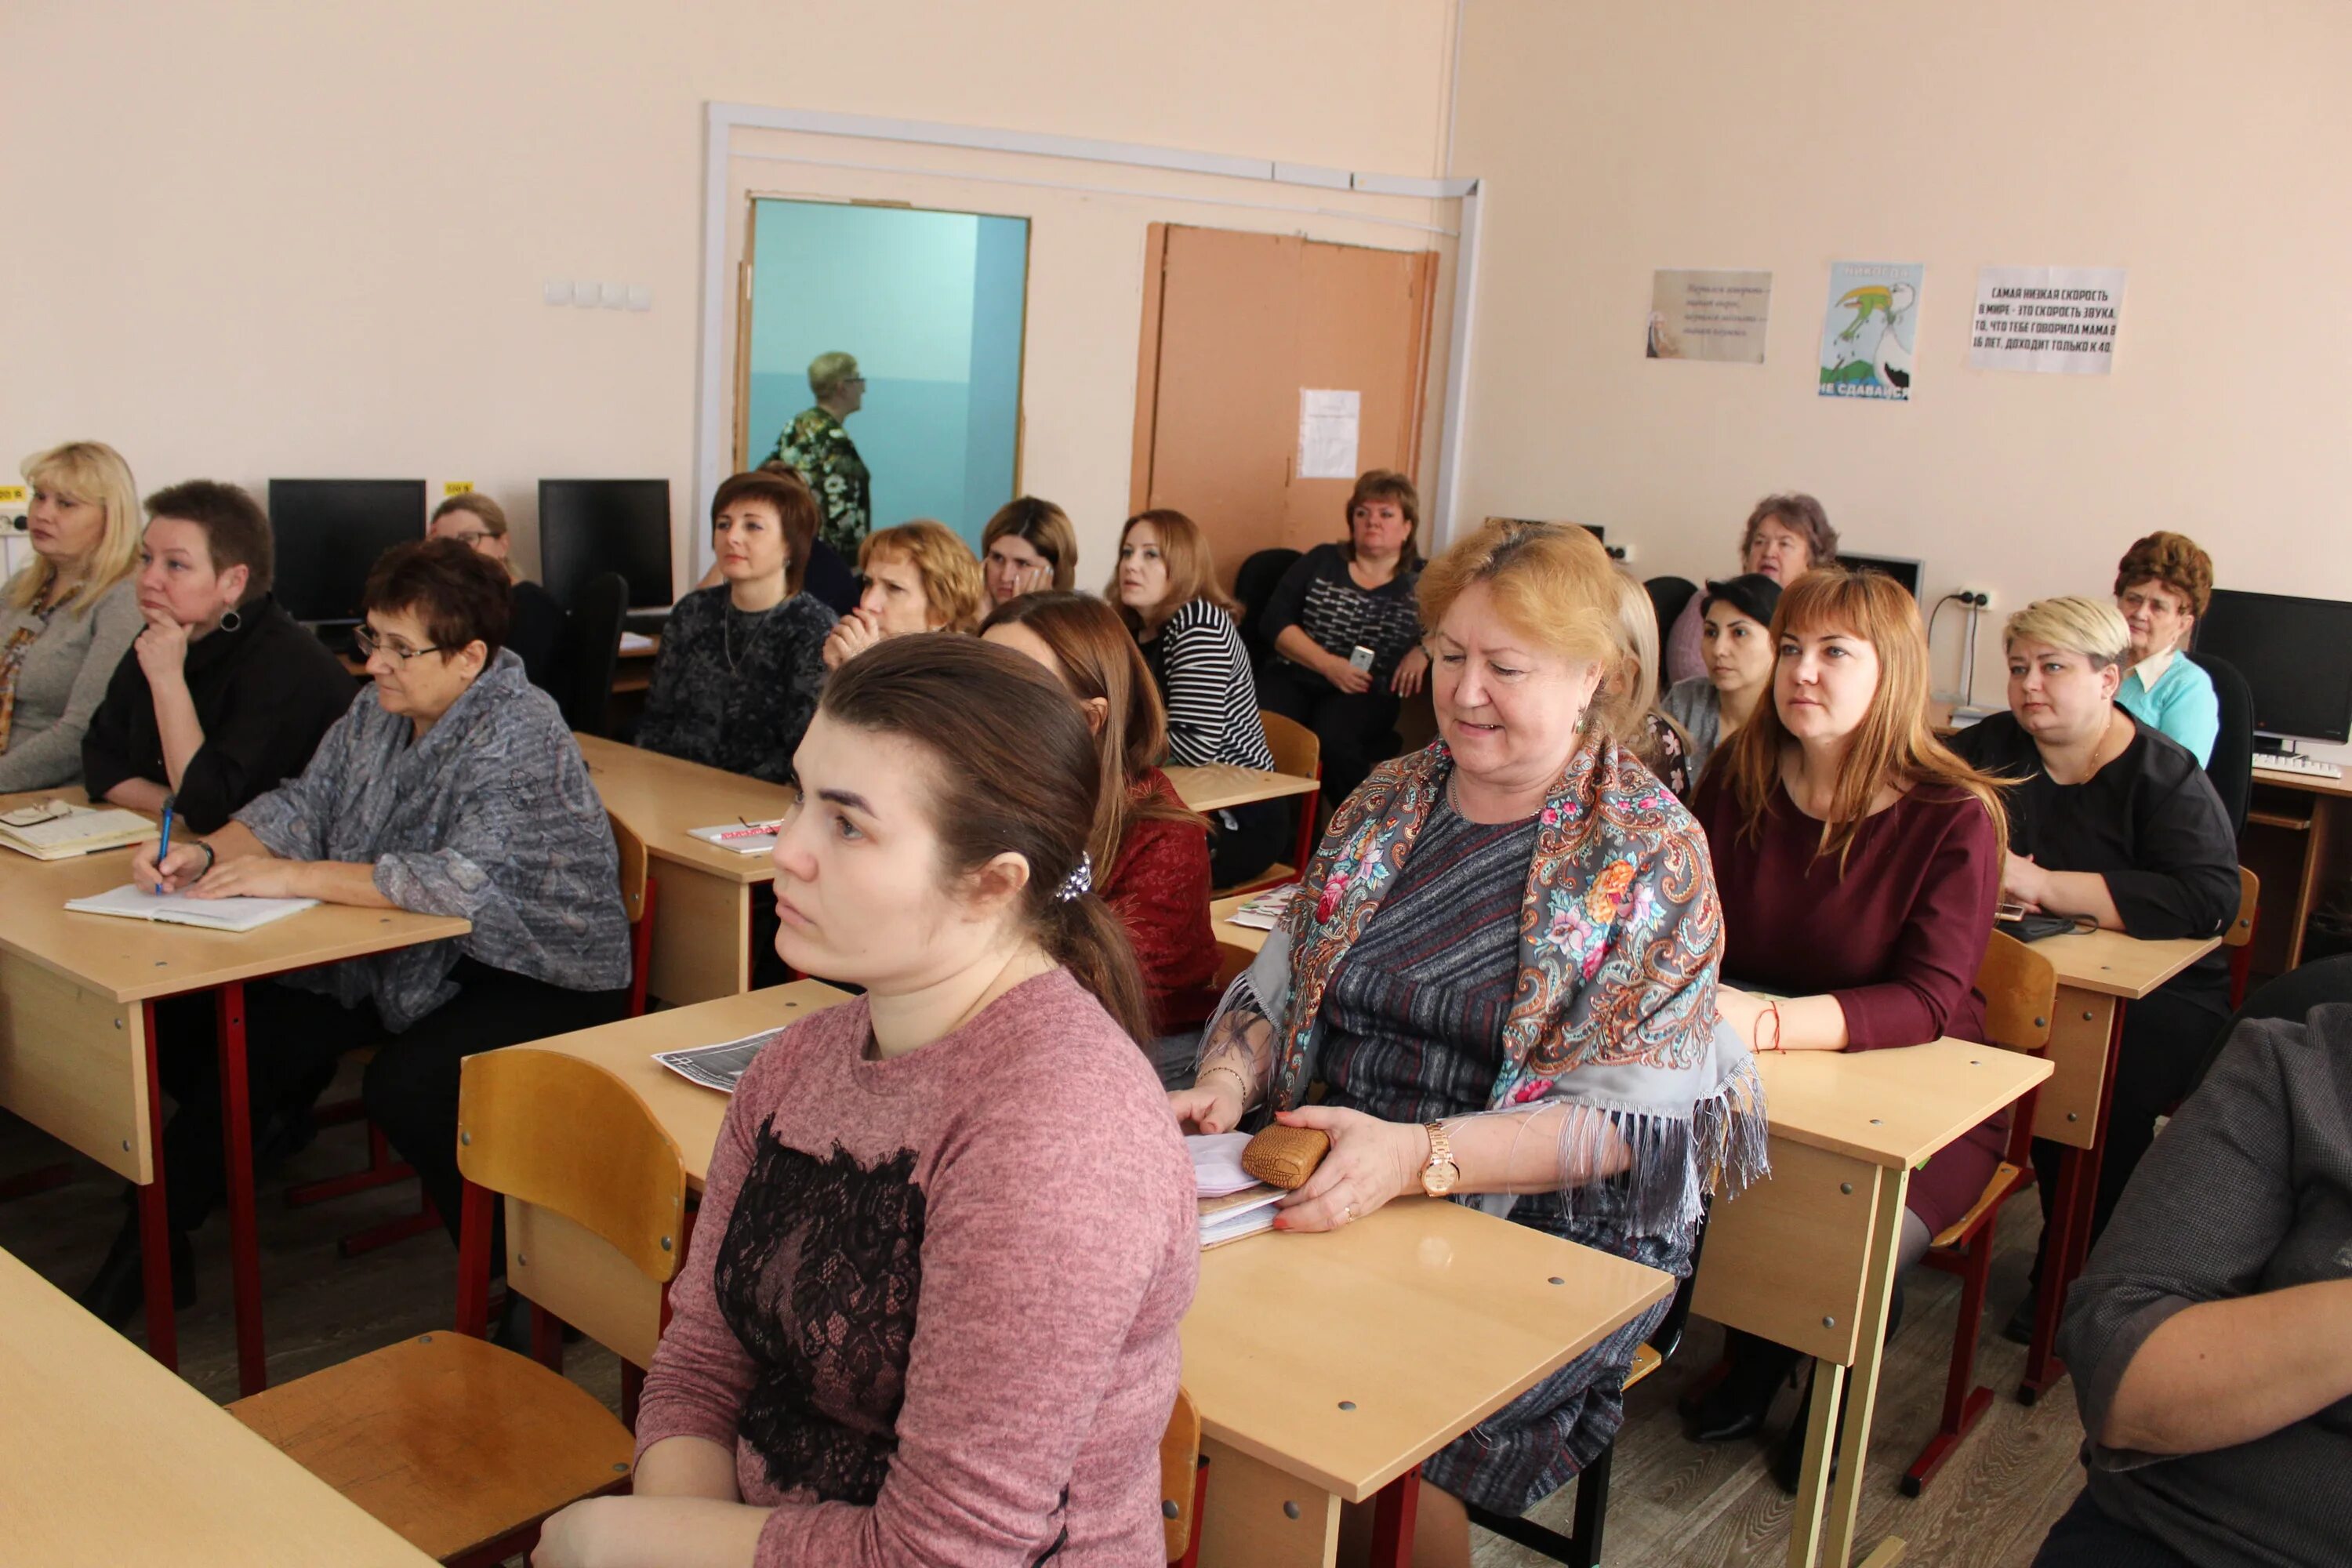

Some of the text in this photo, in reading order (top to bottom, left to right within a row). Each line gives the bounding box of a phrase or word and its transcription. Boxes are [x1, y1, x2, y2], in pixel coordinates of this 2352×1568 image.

[1992, 287, 2108, 301] САМАЯ НИЗКАЯ СКОРОСТЬ
[1978, 303, 1984, 314] В
[1986, 303, 2010, 315] МИРЕ
[2018, 305, 2033, 316] ЭТО
[2034, 306, 2081, 318] СКОРОСТЬ
[1990, 321, 2007, 332] ЧТО
[2009, 321, 2028, 333] ТЕБЕ
[2031, 322, 2079, 335] ГОВОРИЛА
[2081, 324, 2108, 336] МАМА
[2110, 325, 2116, 336] В
[2005, 338, 2049, 351] ДОХОДИТ
[2051, 339, 2089, 351] ТОЛЬКО
[2090, 341, 2098, 352] К
